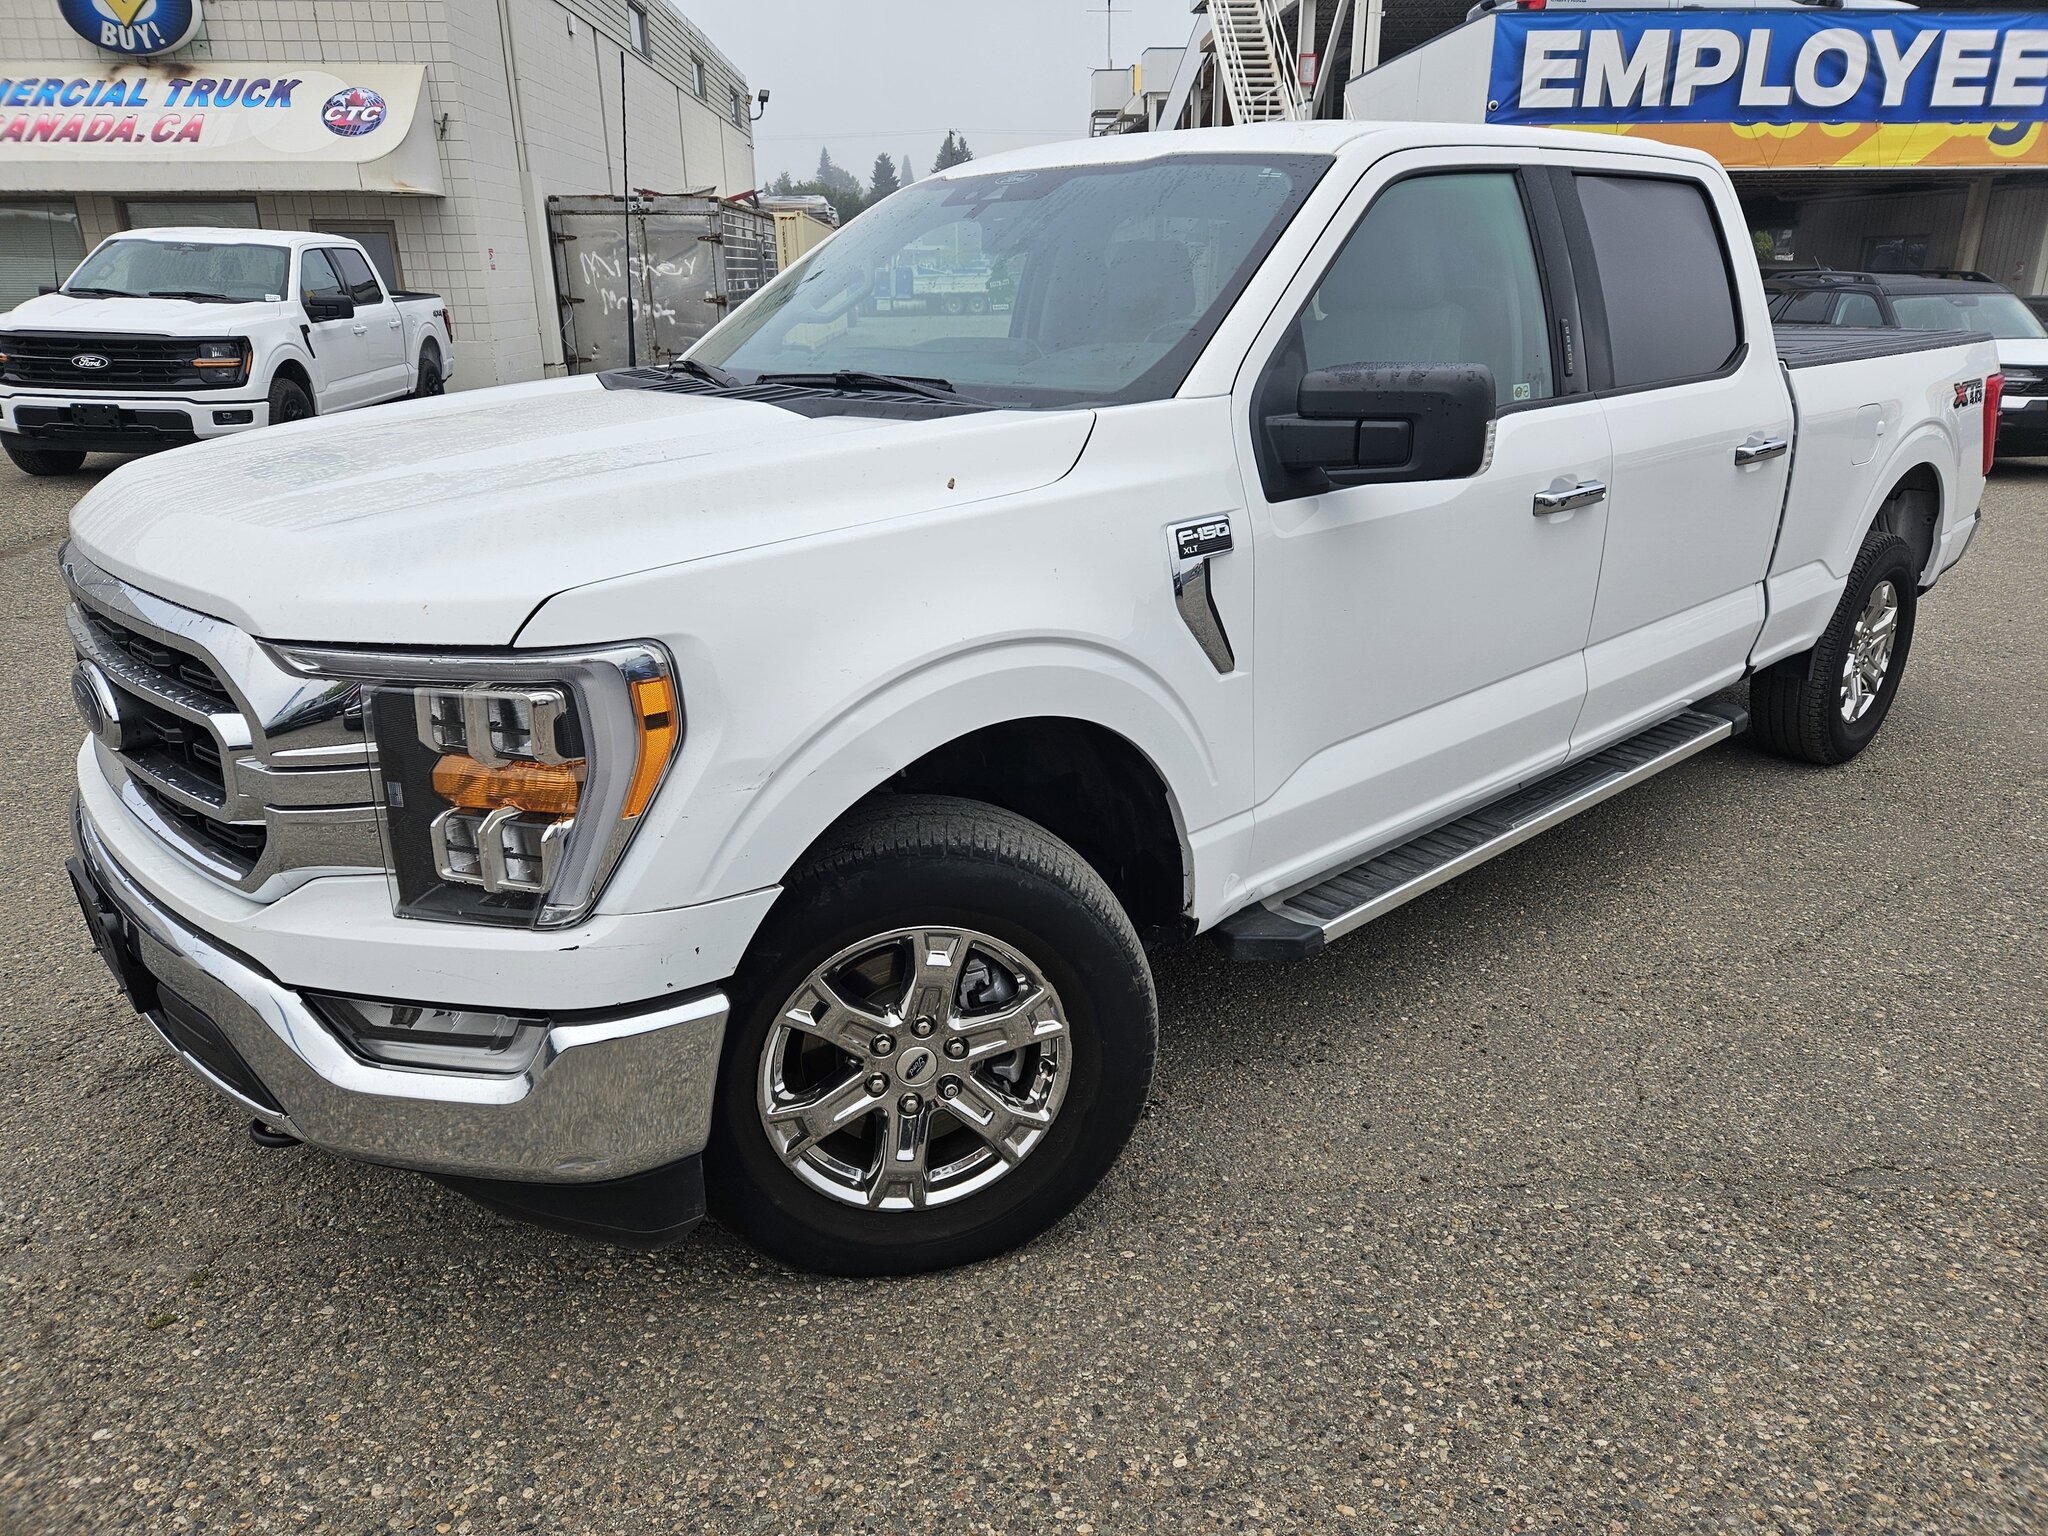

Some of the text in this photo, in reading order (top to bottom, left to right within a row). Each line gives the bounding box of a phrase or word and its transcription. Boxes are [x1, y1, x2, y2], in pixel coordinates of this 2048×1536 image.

[100, 20, 166, 50] BUY!
[1518, 28, 2048, 110] EMPLOYEE
[164, 78, 302, 108] TRUCK
[324, 105, 382, 122] CTC
[0, 113, 205, 143] ANADA.CA
[78, 356, 101, 367] Ford
[1178, 523, 1229, 545] F-150
[1183, 544, 1199, 555] XLT
[908, 1056, 926, 1077] Ford
